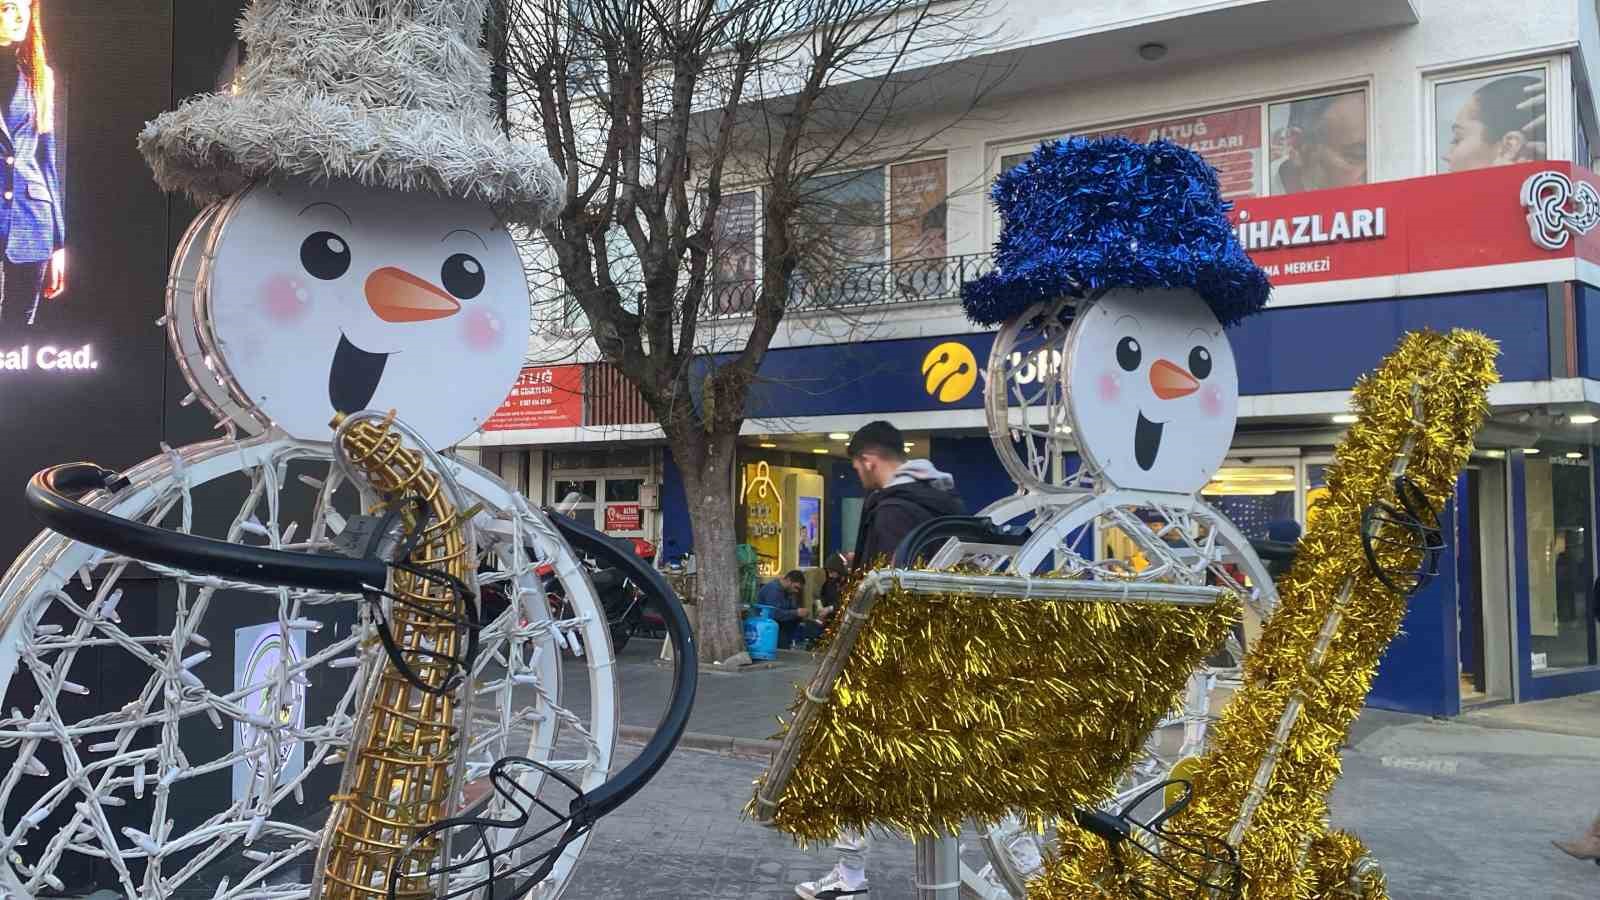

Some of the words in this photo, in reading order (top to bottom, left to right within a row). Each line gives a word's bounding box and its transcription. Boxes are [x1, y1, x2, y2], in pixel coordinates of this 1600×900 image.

[1235, 206, 1387, 250] İHAZLARI
[1284, 256, 1330, 275] MERKEZİ
[36, 343, 98, 370] Cad.
